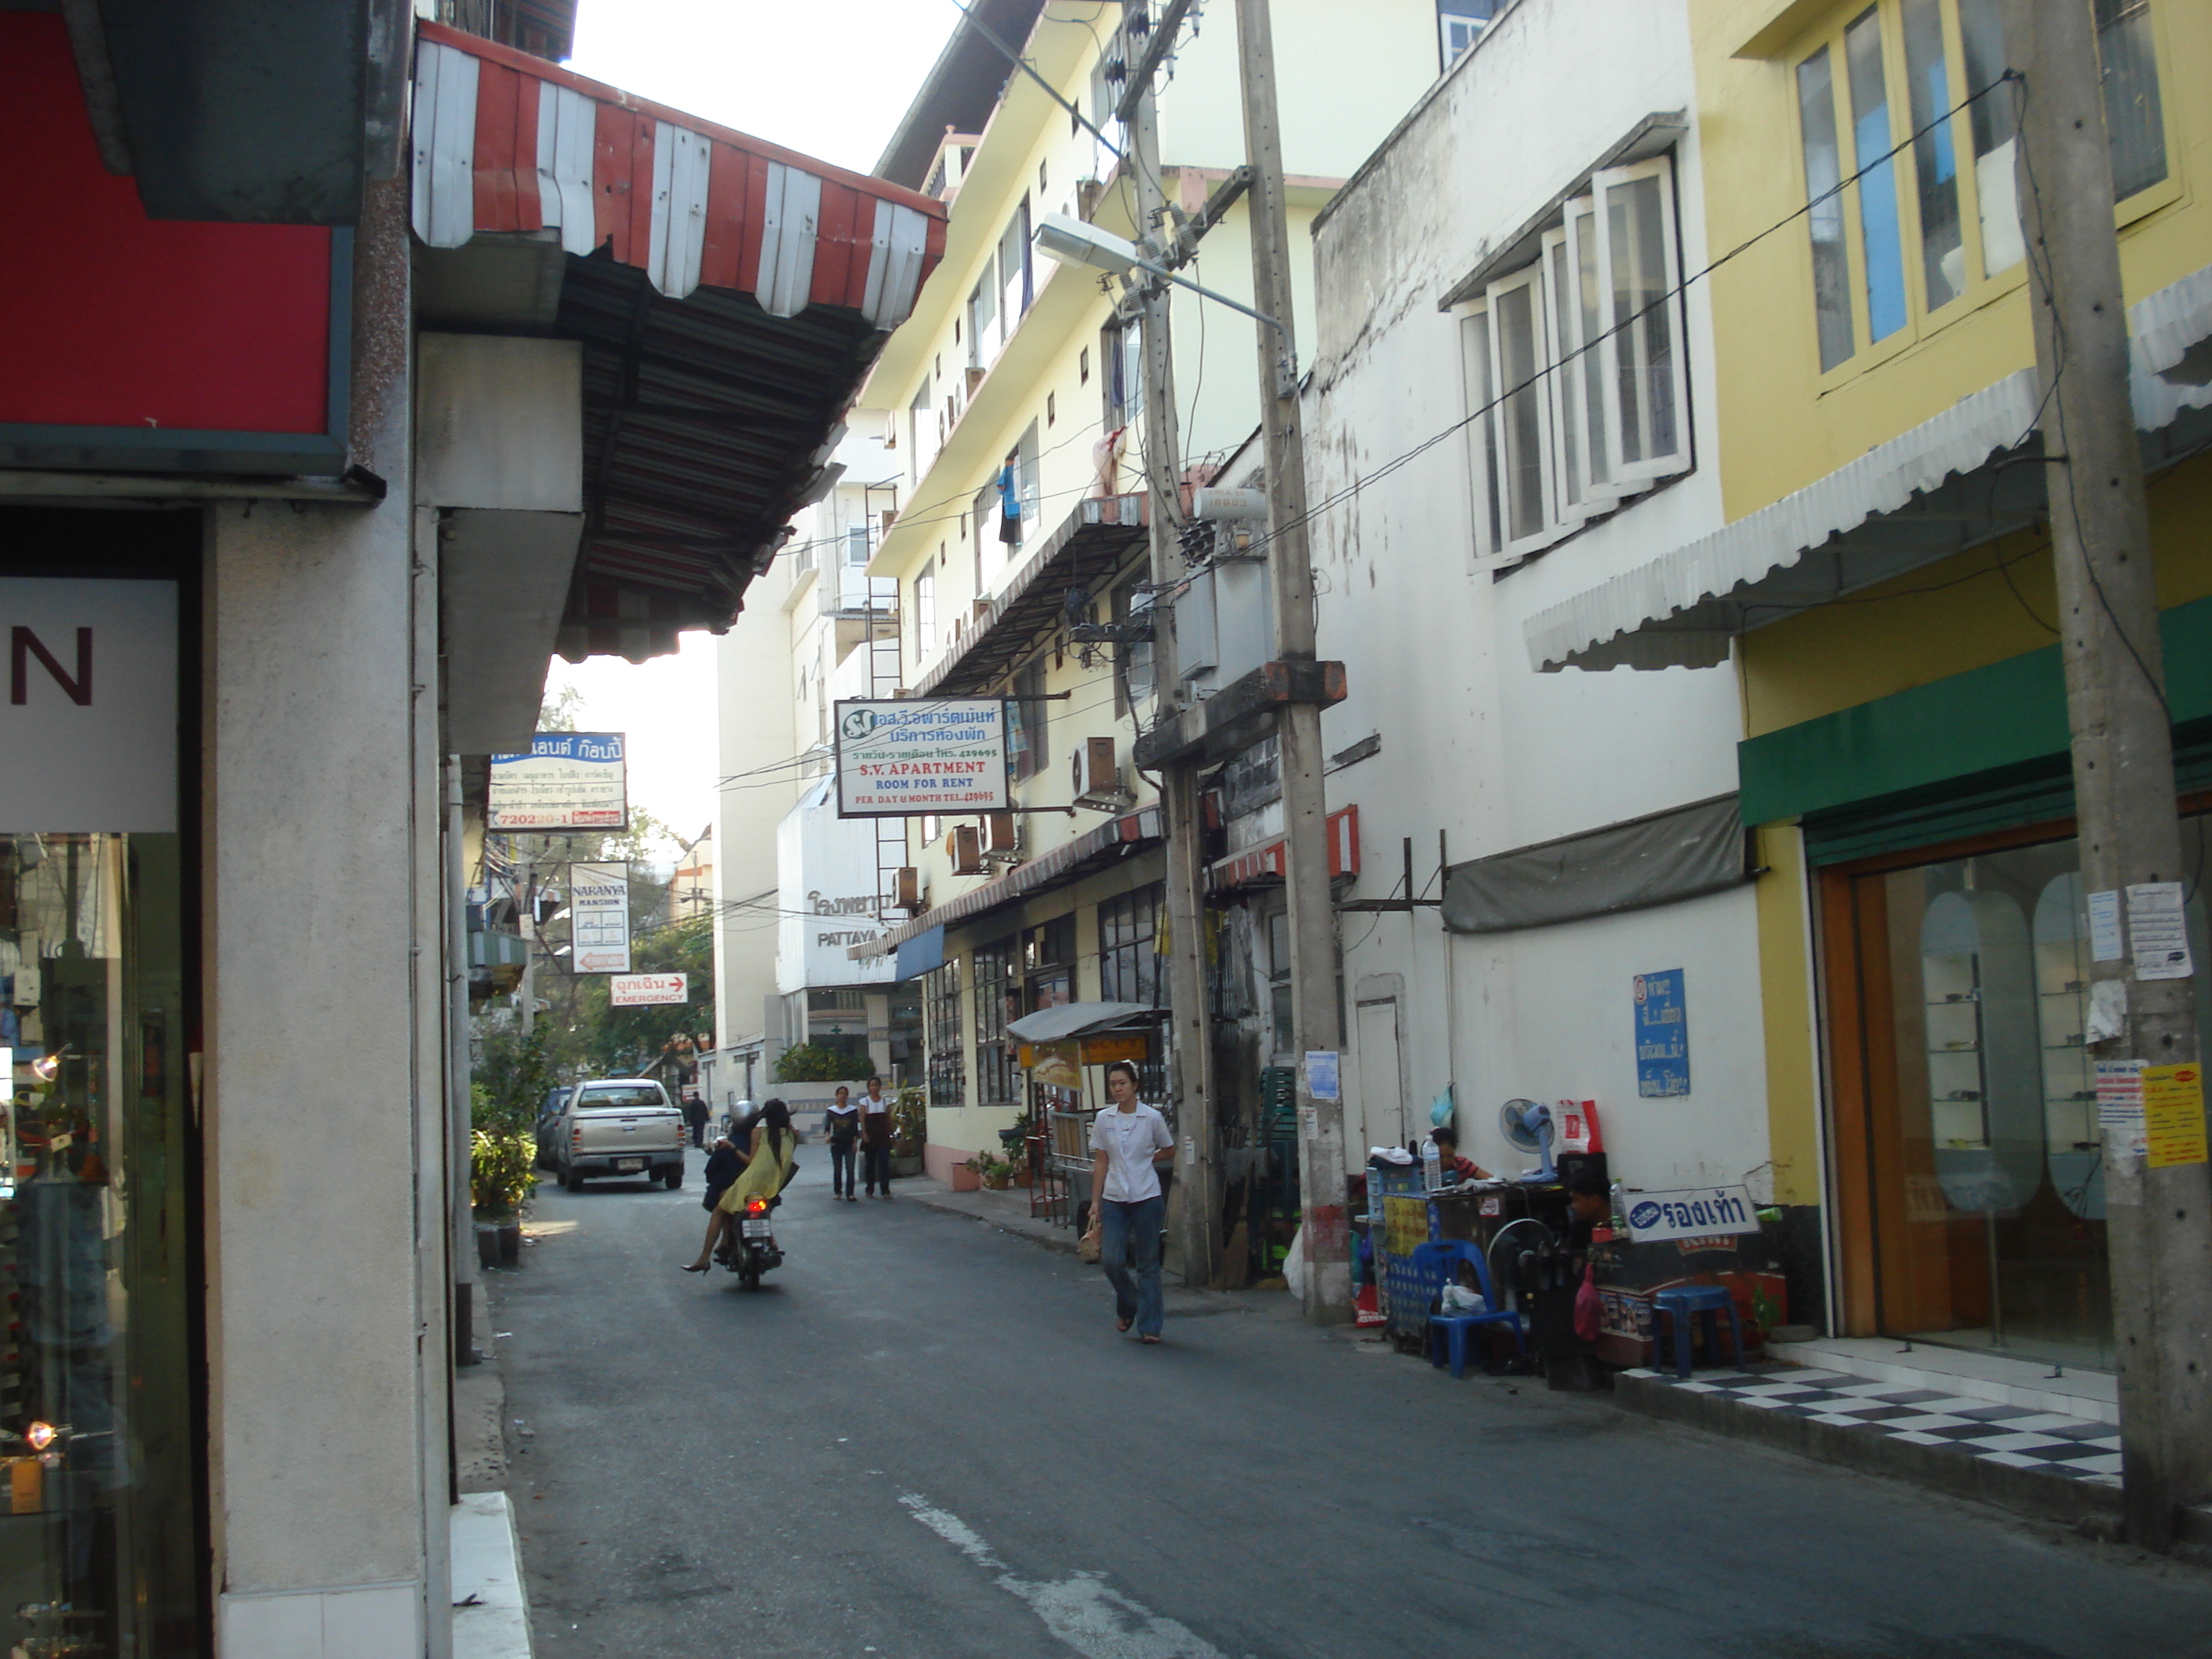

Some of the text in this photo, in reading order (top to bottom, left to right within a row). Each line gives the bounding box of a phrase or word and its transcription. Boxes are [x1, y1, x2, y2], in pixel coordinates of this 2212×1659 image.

[890, 727, 986, 742] บริการห้องพัก
[935, 747, 957, 758] โทร.
[958, 749, 997, 757] 429695
[859, 761, 986, 776] S.V. APARTMENT
[876, 778, 974, 790] ROOM FOR RENT
[855, 796, 873, 804] PER
[878, 795, 899, 804] DAY
[908, 793, 942, 803] MONTH
[500, 814, 568, 824] 720220-1
[572, 886, 626, 897] NARANYA
[817, 930, 878, 948] PATTAYA
[616, 976, 665, 994] ฉุกเฉิน
[615, 994, 684, 1003] EMERGENCY
[1663, 1190, 1746, 1228] รองเท้า
